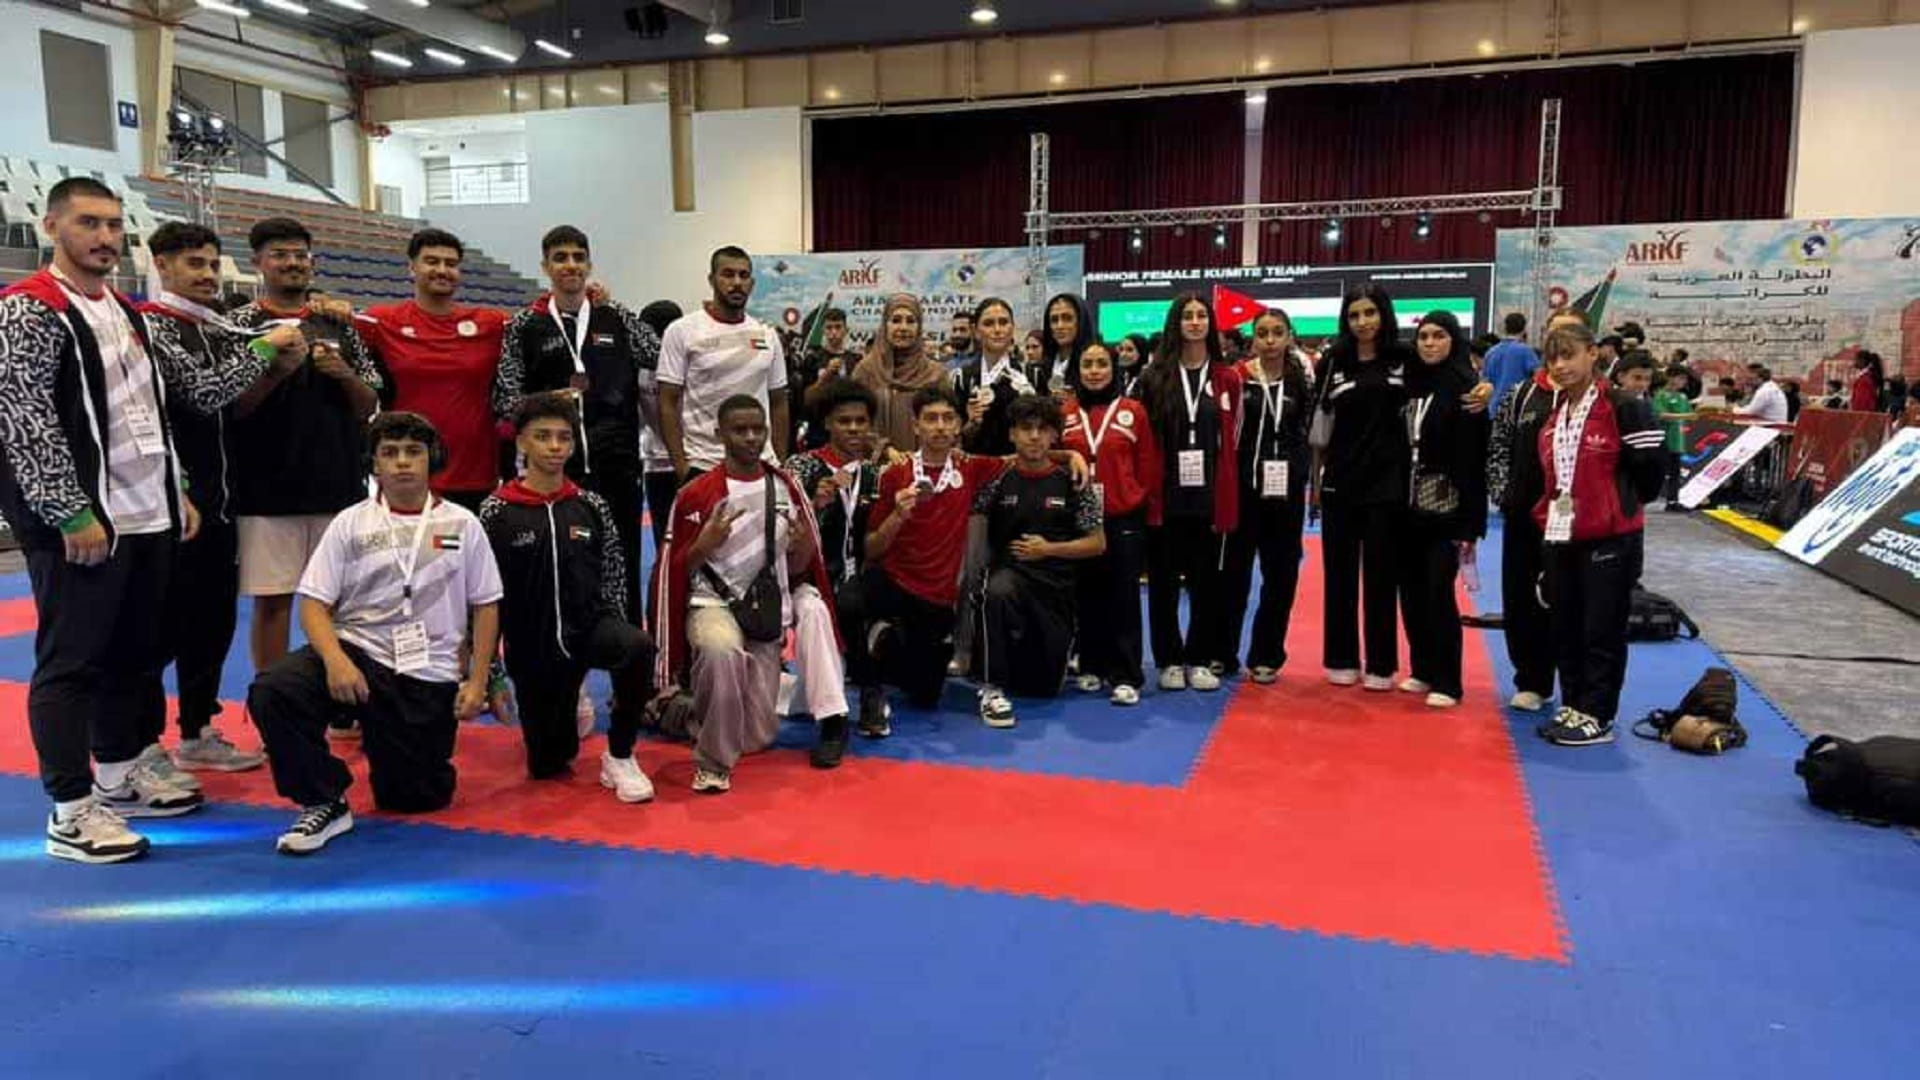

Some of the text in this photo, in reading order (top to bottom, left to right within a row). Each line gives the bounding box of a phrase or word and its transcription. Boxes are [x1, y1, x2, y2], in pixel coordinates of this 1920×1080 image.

[1626, 240, 1688, 262] ARKF
[839, 267, 880, 286] ARKF
[1087, 265, 1309, 282] SENIOR FEMALE KUMITE TEAM
[853, 295, 887, 306] ARA
